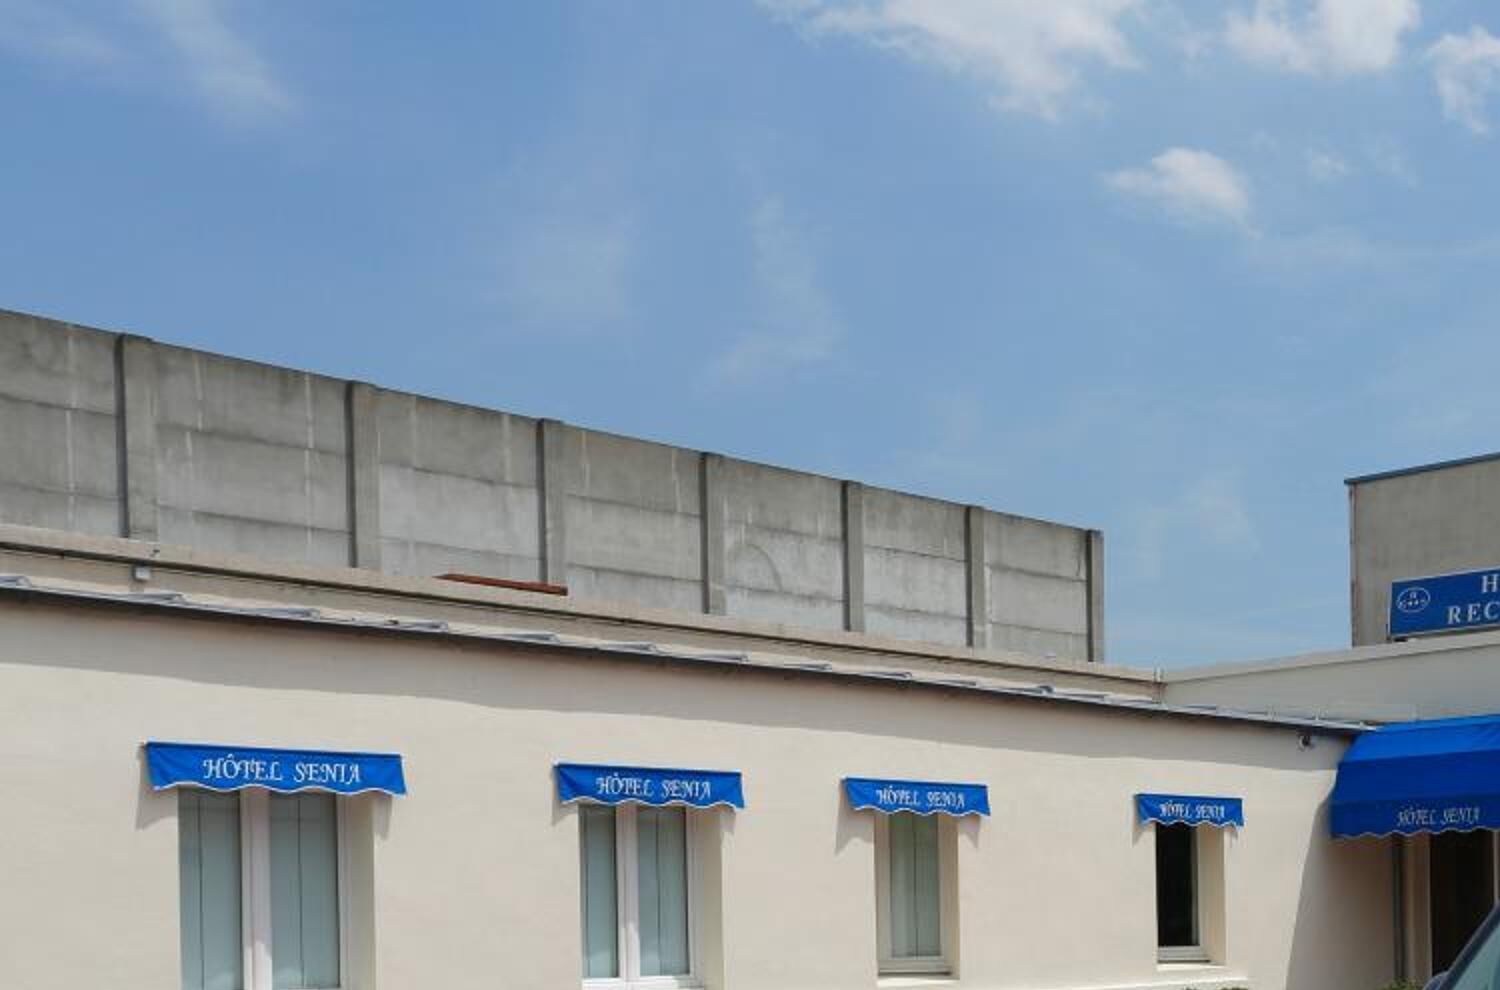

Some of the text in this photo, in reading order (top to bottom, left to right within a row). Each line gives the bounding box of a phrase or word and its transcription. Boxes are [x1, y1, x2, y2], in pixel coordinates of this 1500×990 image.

[203, 753, 361, 785] HÔTEL SENIA
[595, 772, 712, 800] HÔTEL SENIA
